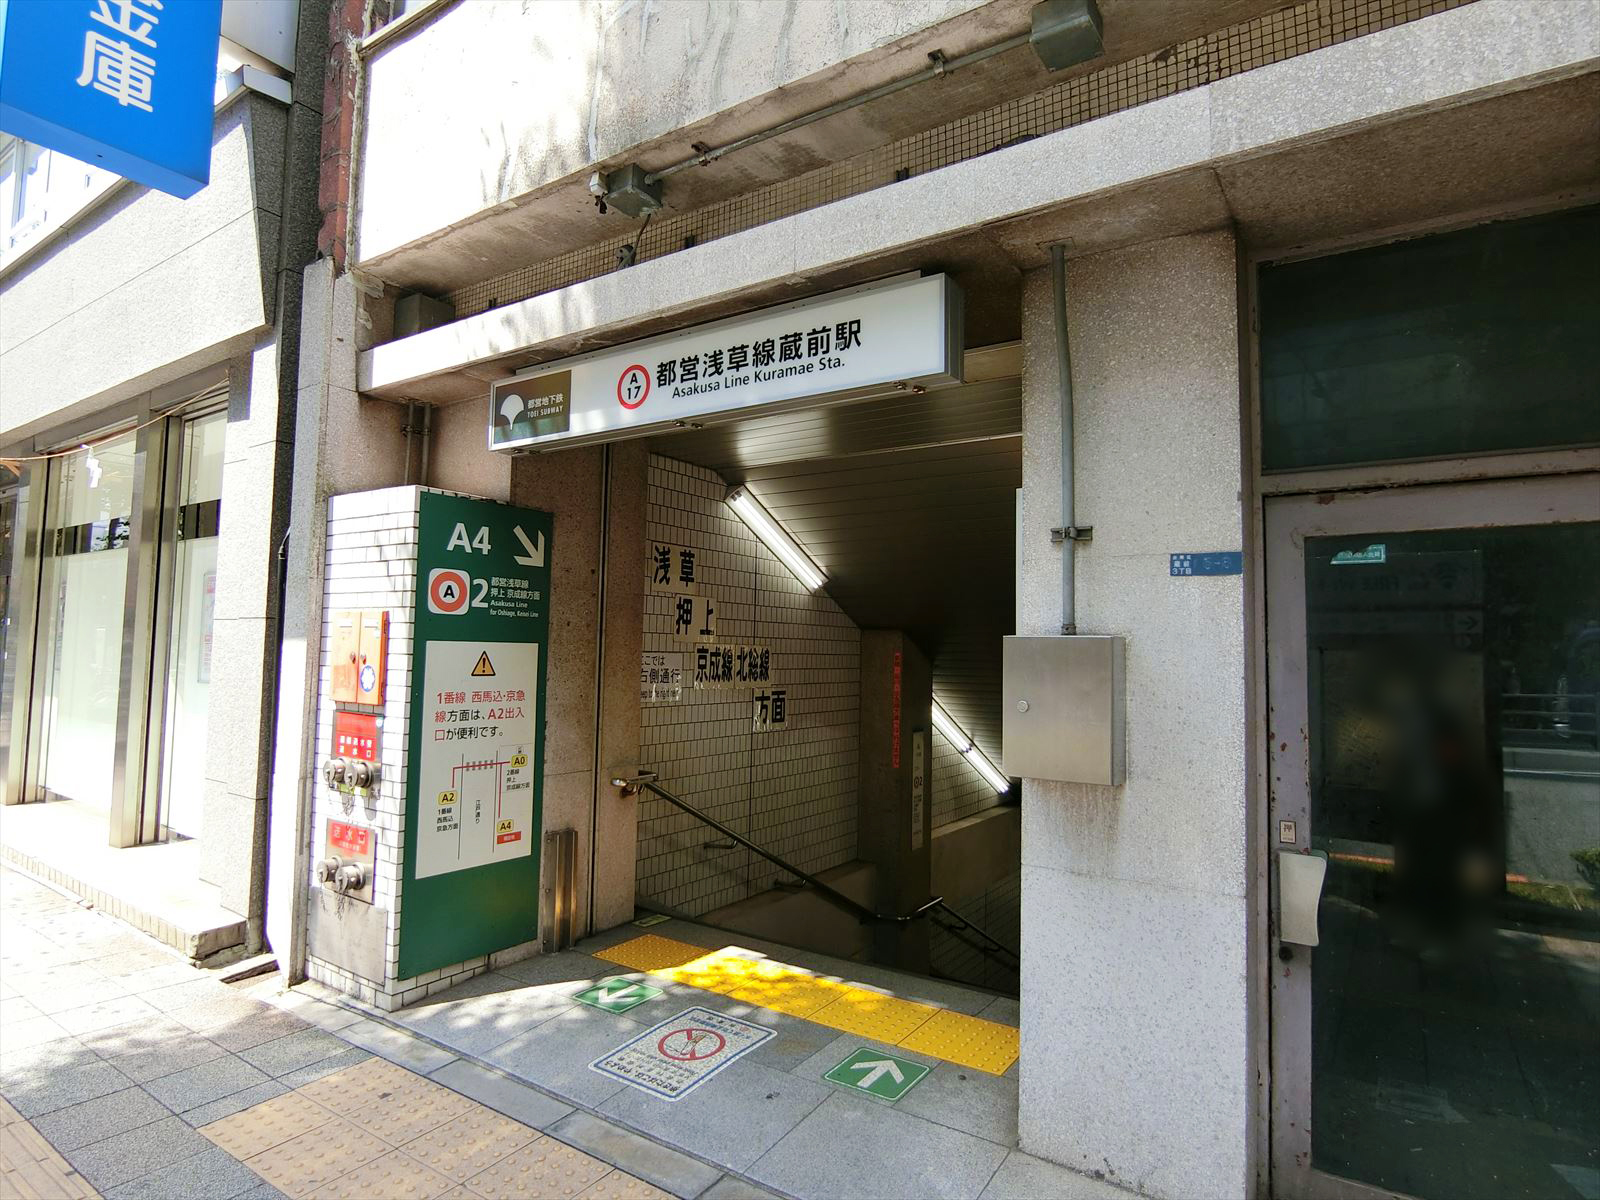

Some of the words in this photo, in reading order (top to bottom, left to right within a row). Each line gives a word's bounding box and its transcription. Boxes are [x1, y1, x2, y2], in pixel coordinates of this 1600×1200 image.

[656, 319, 862, 388] 都営浅草線蔵前駅
[629, 373, 639, 385] A
[672, 379, 720, 399] Asakusa
[724, 374, 751, 391] Line
[754, 363, 814, 383] Kuramae
[819, 356, 845, 373] Sta.
[626, 385, 642, 400] 17
[528, 393, 564, 409] 都営地下鉄
[527, 410, 539, 418] TOEI
[540, 405, 564, 416] SUBWAY
[446, 522, 491, 555] A4
[653, 545, 696, 587] 浅草
[491, 576, 529, 589] 都営浅草線
[443, 585, 455, 599] A
[471, 578, 489, 608] 2
[490, 587, 505, 598] 押上
[490, 600, 515, 608] Asakusa
[676, 597, 715, 636] 押上
[437, 691, 466, 704] 1番線
[755, 690, 786, 725] 方面
[434, 725, 504, 741] 口が便利です。
[514, 757, 525, 765] A0
[442, 793, 455, 803] A2
[500, 821, 512, 831] A4
